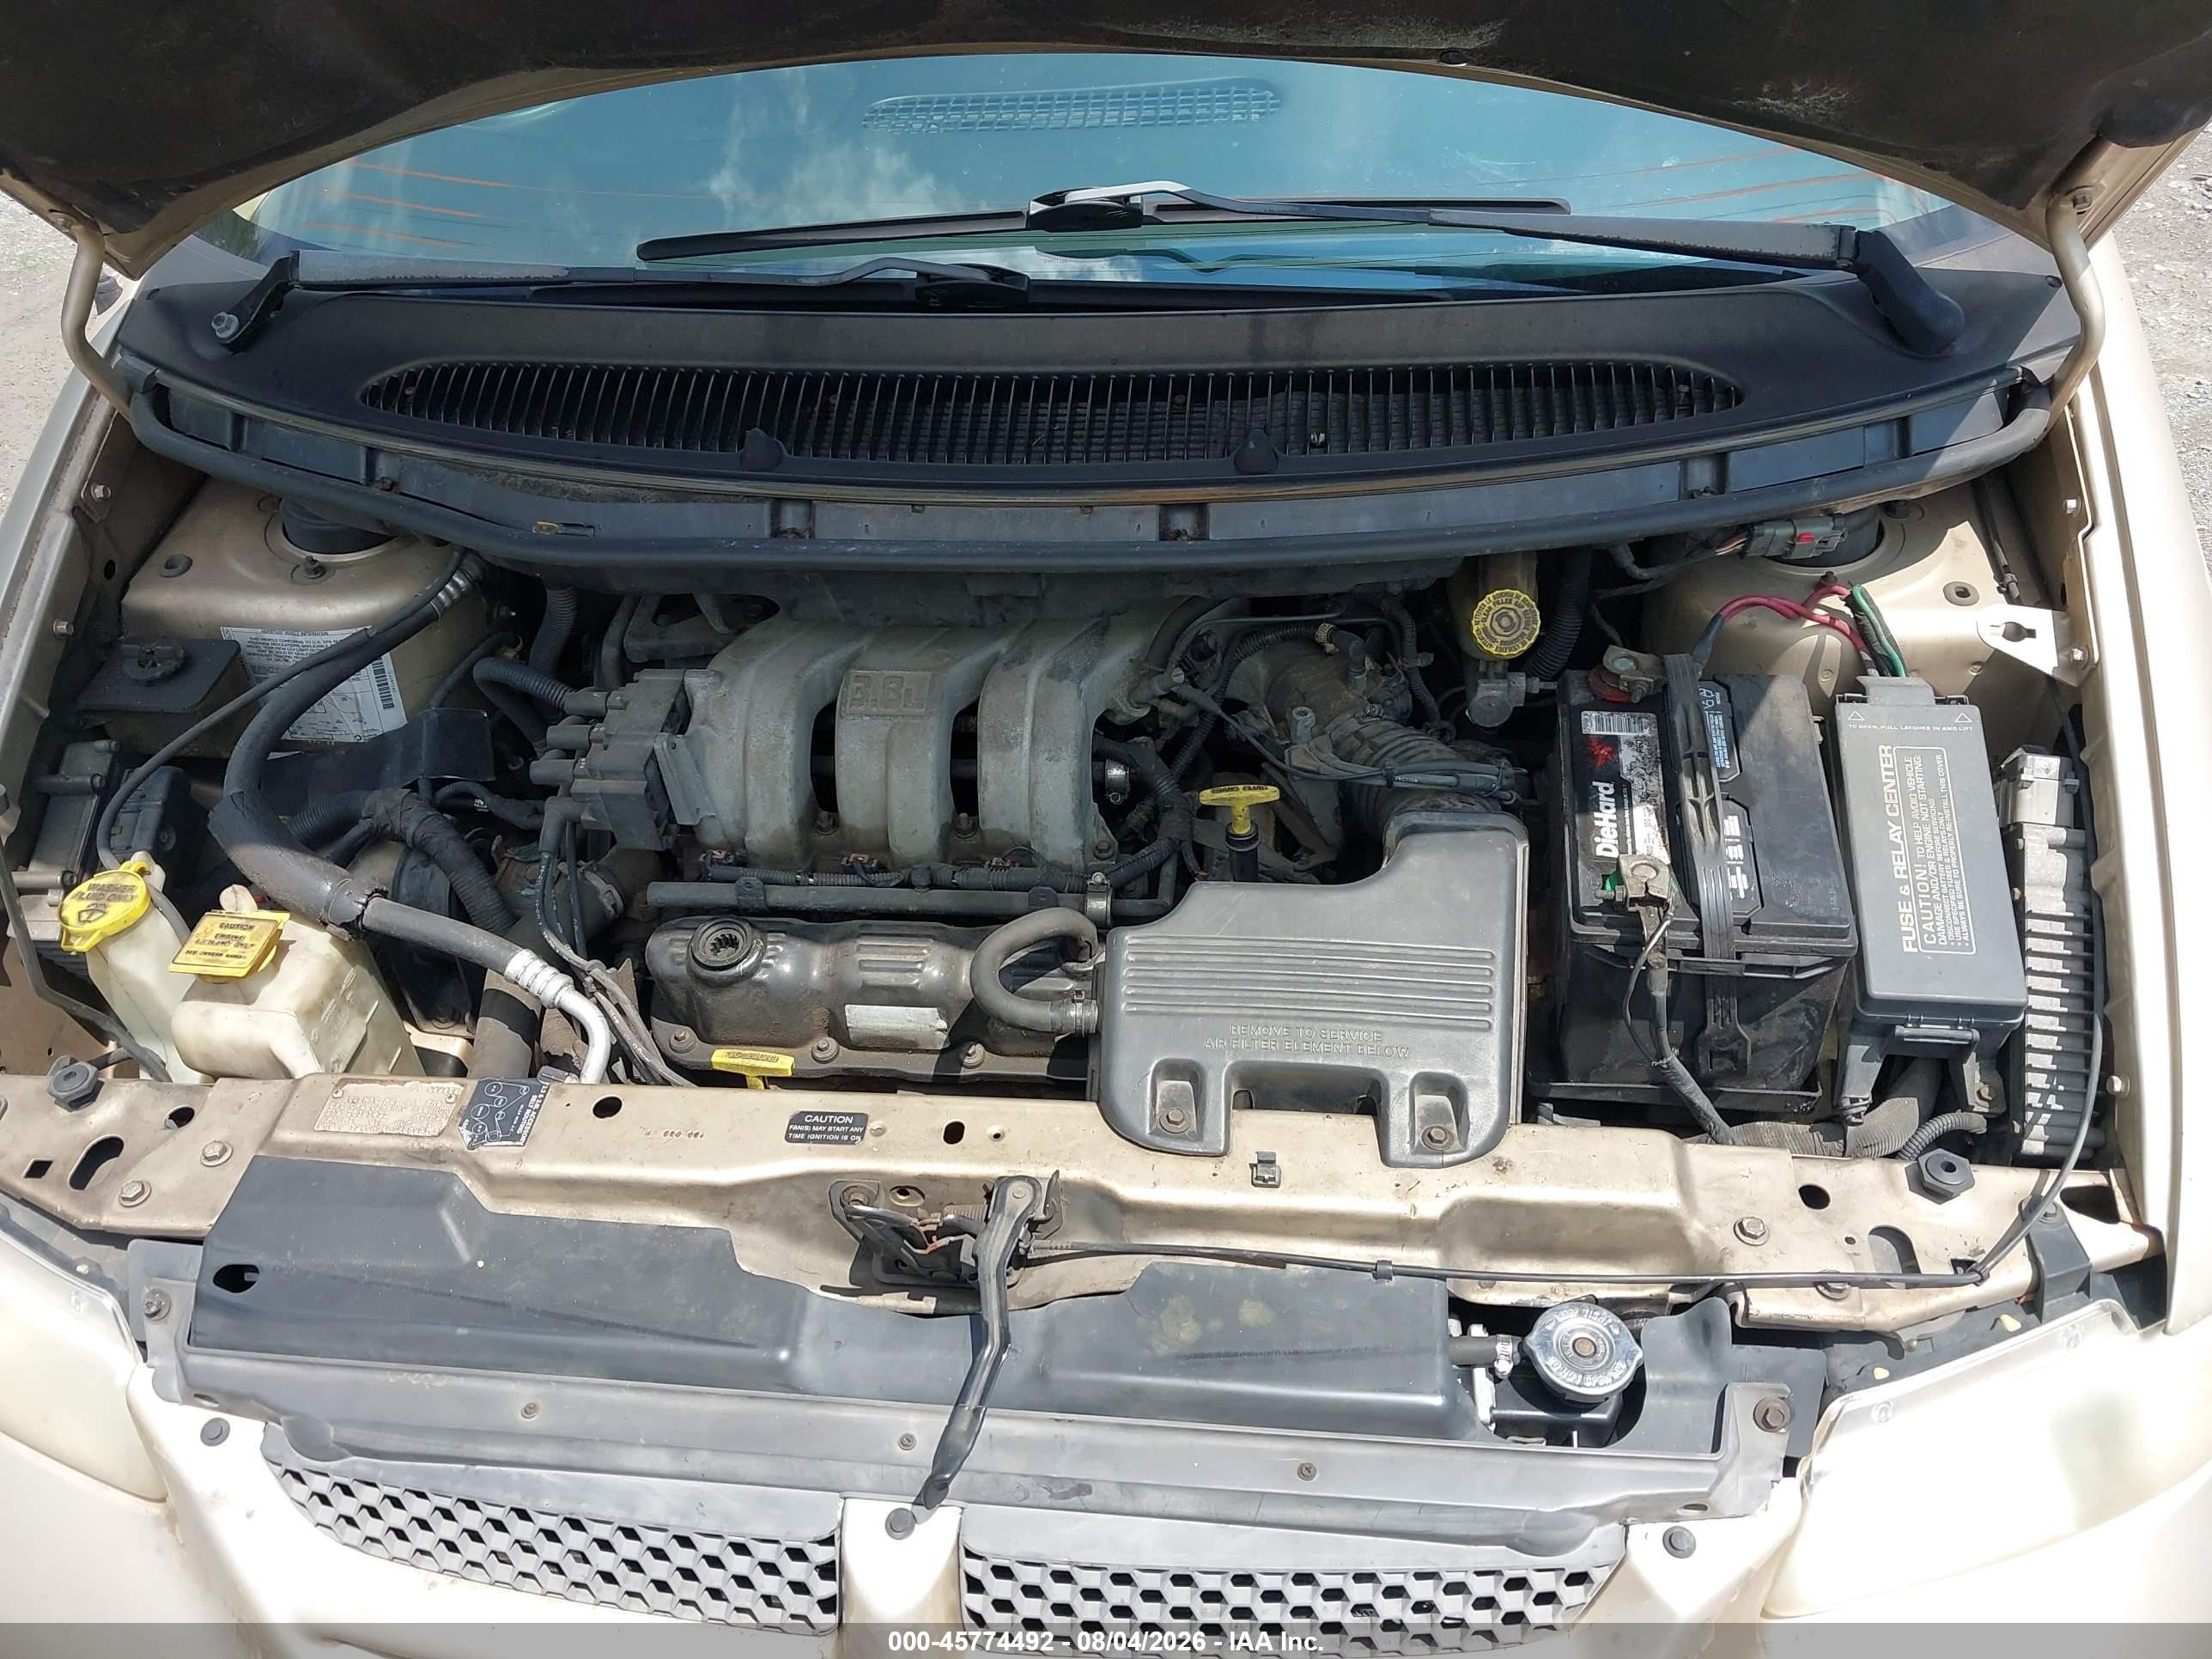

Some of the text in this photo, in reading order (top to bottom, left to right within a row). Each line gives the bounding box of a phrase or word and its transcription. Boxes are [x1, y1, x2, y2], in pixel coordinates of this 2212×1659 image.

[849, 674, 927, 711] 3.8L
[1939, 777, 1948, 793] THIS
[1592, 781, 1619, 858] DieHard
[1919, 802, 1929, 821] NOT
[1937, 812, 1946, 830] ONLY
[1942, 793, 1955, 831] RE-INSTALL
[1879, 744, 1918, 952] FUSE & RELAY CENTER
[1905, 756, 1936, 945] CAUTION! TO HELP AVOID VEHICLE
[1923, 824, 1936, 859] ENGINE
[1940, 830, 1948, 856] RELAYS
[1947, 832, 1959, 868] PROPERLY
[1928, 861, 1942, 901] AND/OR
[1929, 799, 1954, 940] DISCONNECT BATTERY BEFORE SERVICING
[1945, 865, 1954, 887] FUSES
[1953, 870, 1960, 879] TO
[72, 891, 138, 902] FLUID ONLY
[87, 884, 138, 893] WASHER
[1954, 879, 1964, 900] SURE
[1949, 889, 1959, 925] SPECIFIED
[1957, 902, 1965, 911] BE
[219, 922, 255, 931] CAUTION
[1934, 902, 1948, 945] DAMAGE
[1959, 911, 1969, 941] ALWAYS
[1231, 1024, 1382, 1042] REMOVE TO SERVICE
[1203, 1036, 1409, 1058] AIR FILTER ELEMENT BELOW
[517, 1095, 538, 1134] BELT ROUTING
[804, 1115, 854, 1125] CAUTION
